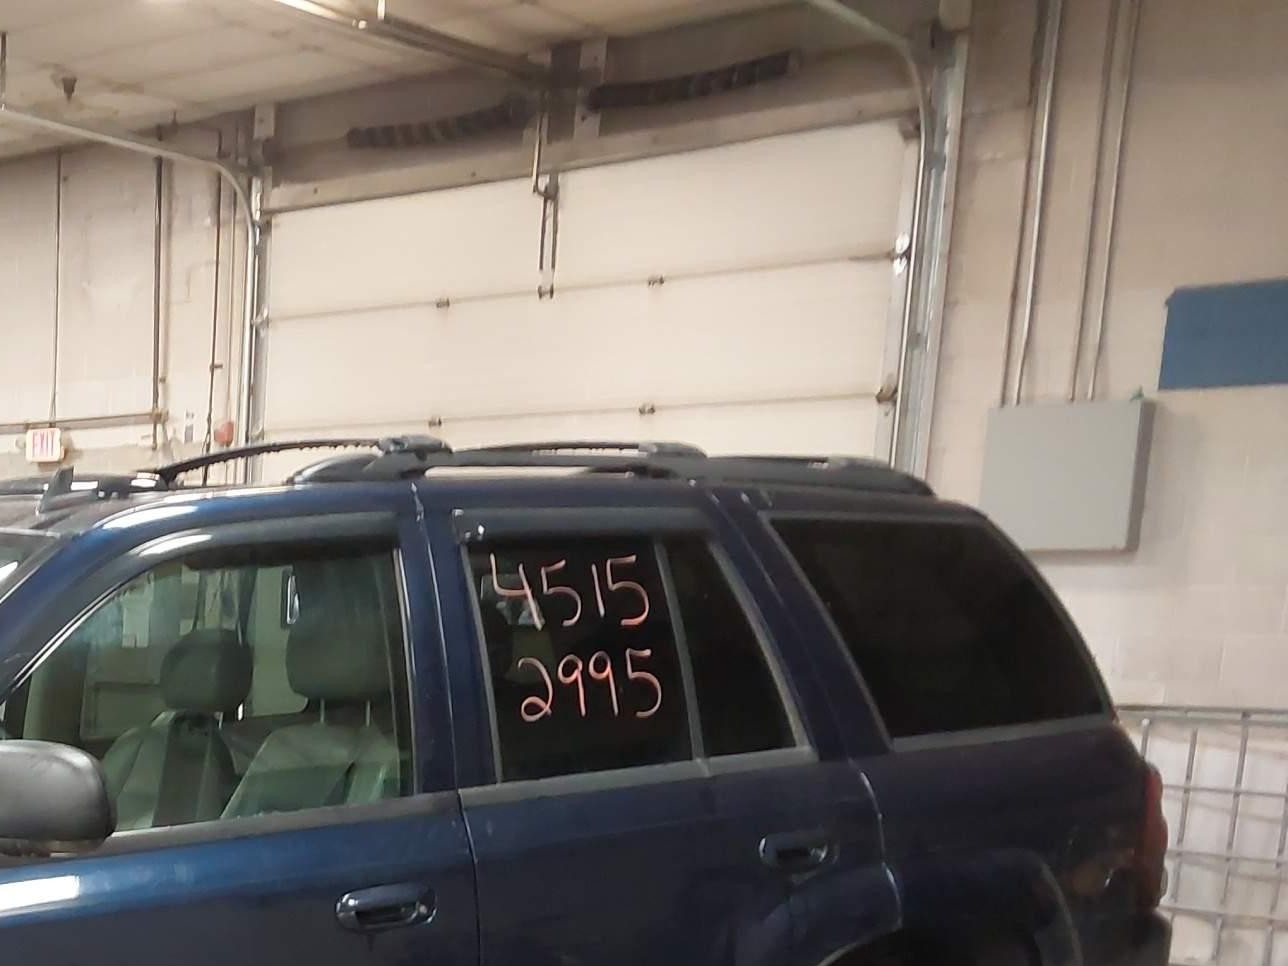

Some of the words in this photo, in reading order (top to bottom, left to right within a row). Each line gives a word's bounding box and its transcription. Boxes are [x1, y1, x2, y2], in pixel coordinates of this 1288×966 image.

[32, 431, 55, 457] EXIT
[489, 552, 650, 632] 4515
[517, 647, 663, 723] 2995
